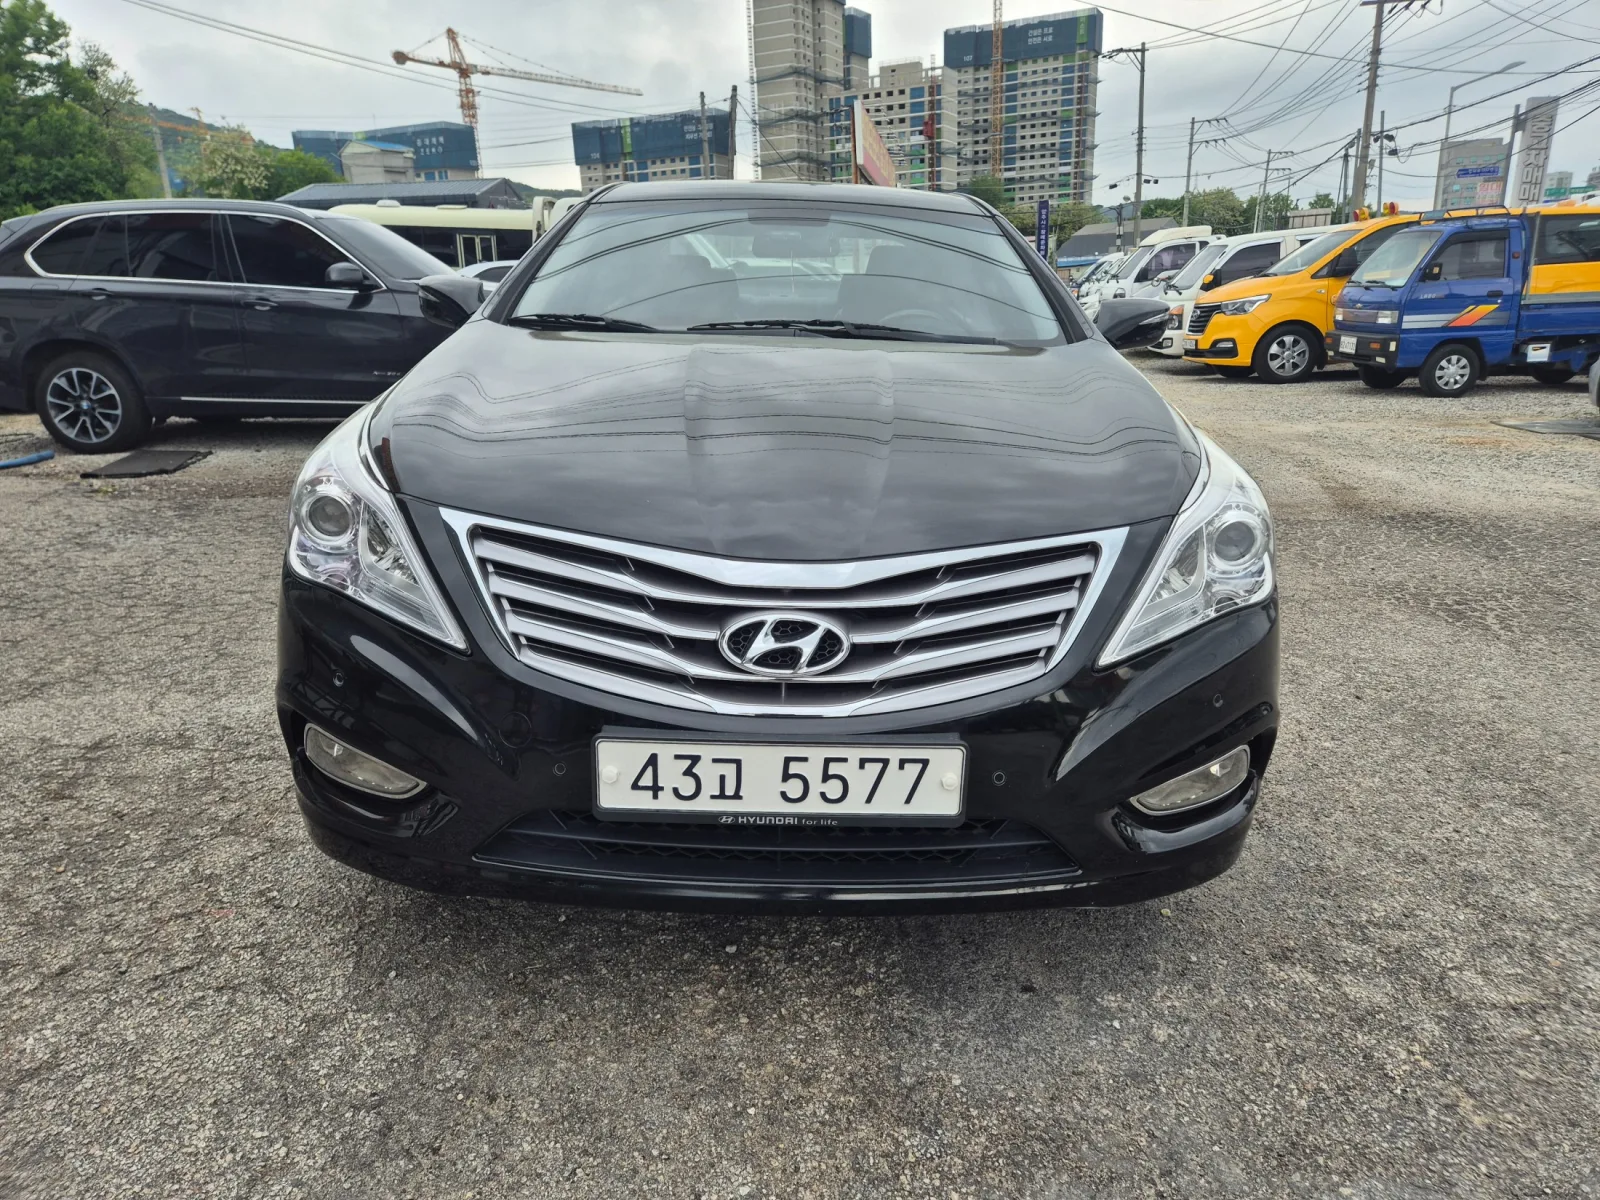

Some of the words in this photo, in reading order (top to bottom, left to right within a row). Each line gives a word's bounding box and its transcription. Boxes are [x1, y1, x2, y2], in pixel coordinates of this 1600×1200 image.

[1518, 115, 1553, 206] 중고차매매
[630, 752, 744, 801] 43고
[779, 756, 931, 805] 5577
[738, 815, 798, 826] HYUNDAI
[802, 817, 818, 826] for
[820, 817, 838, 826] life
